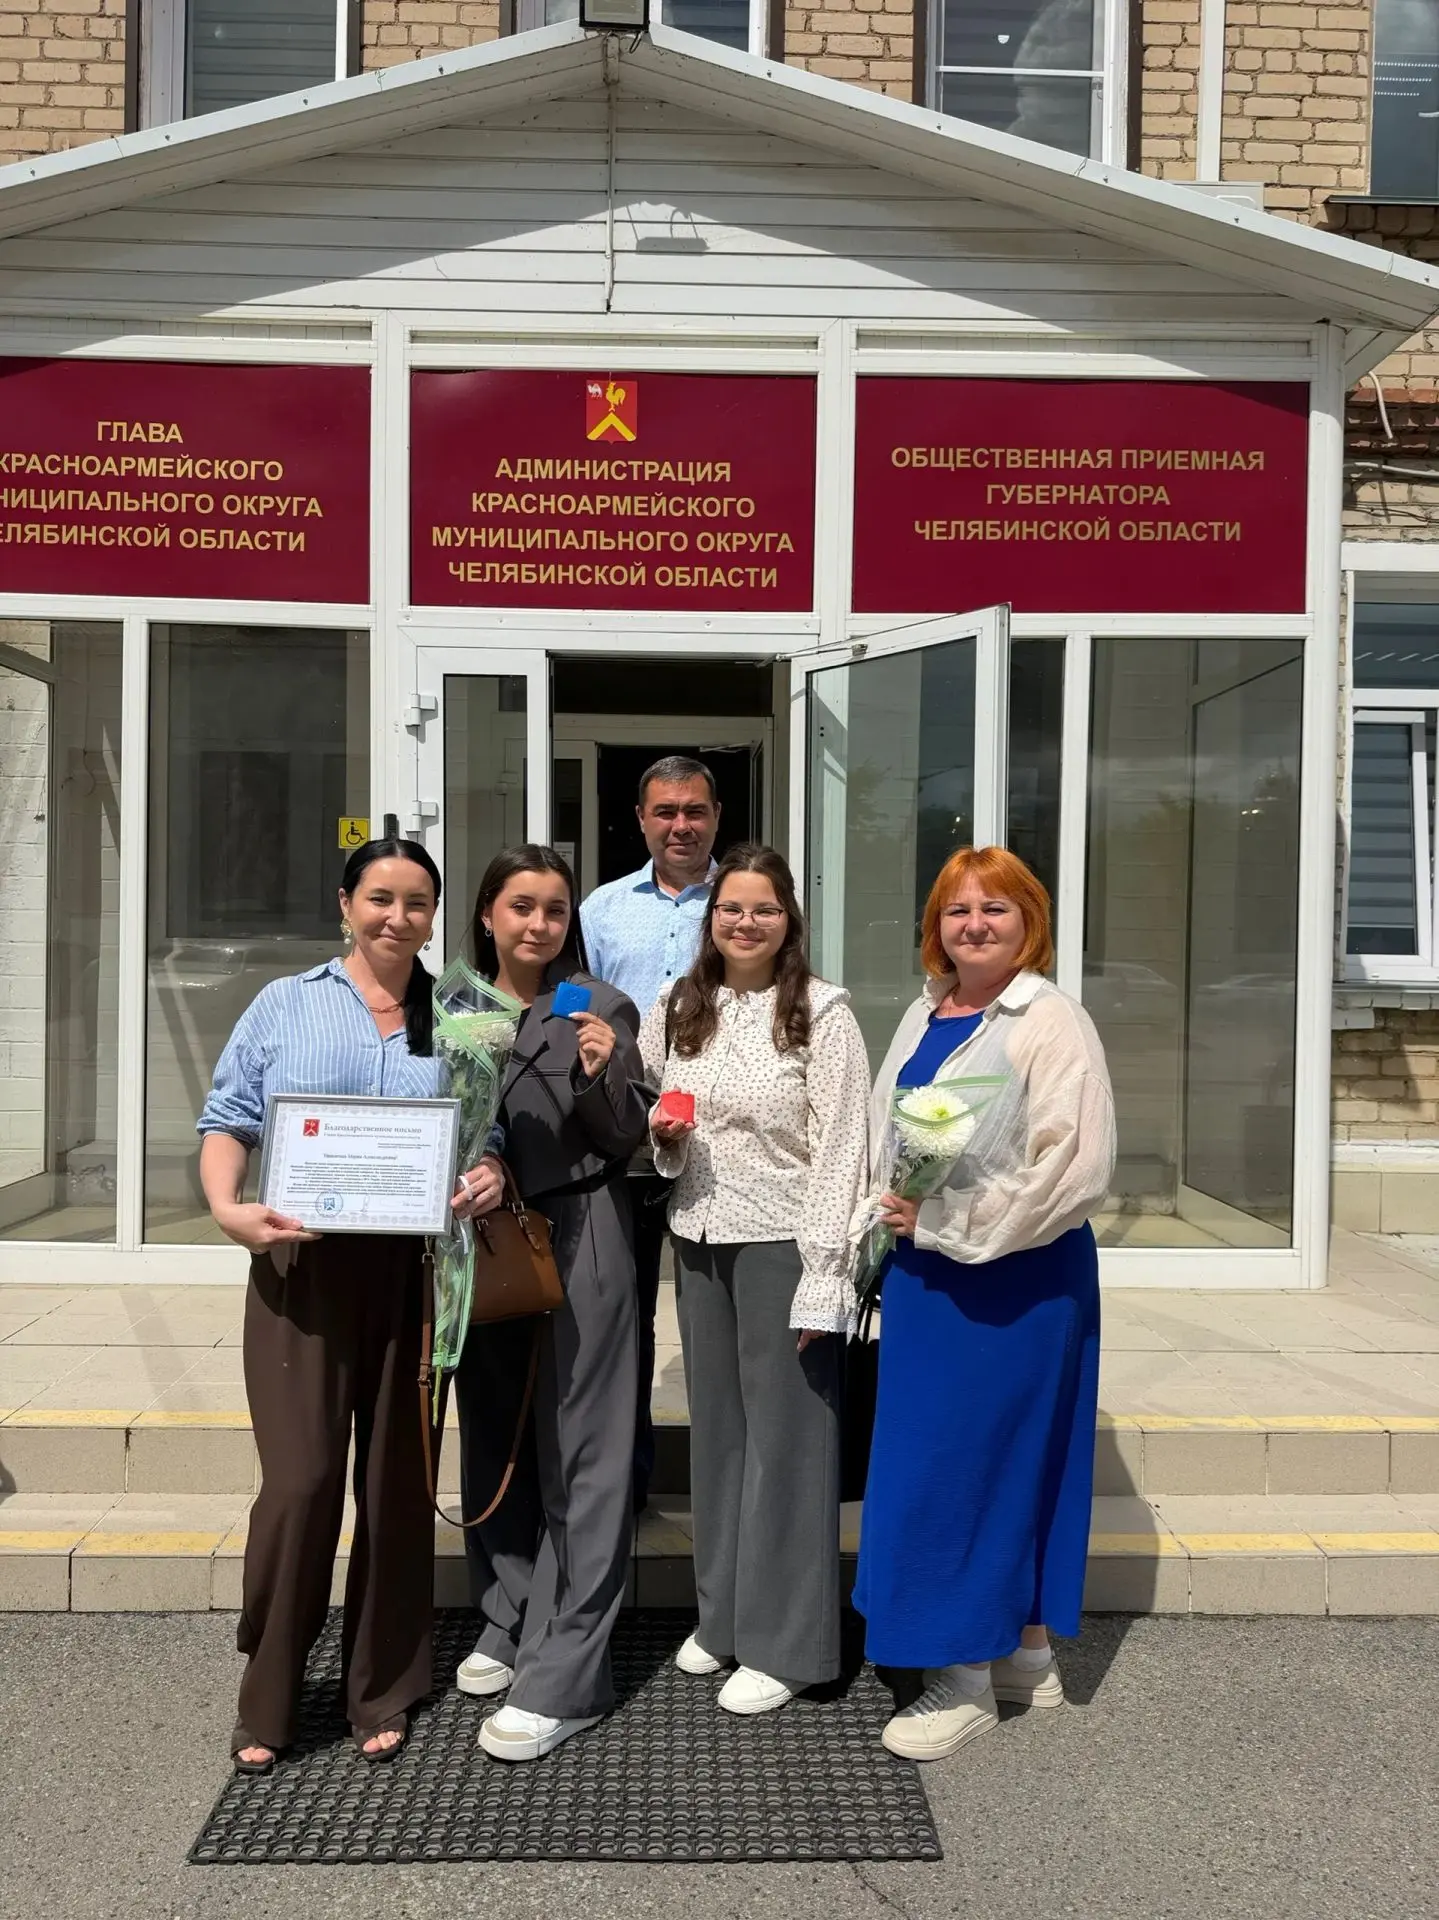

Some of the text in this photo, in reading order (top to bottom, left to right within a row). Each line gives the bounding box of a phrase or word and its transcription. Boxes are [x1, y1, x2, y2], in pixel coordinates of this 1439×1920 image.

[97, 421, 183, 444] ГЛАВА
[0, 453, 283, 481] КРАСНОАРМЕЙСКОГО
[495, 458, 731, 485] АДМИНИСТРАЦИЯ
[891, 447, 1264, 471] ОБЩЕСТВЕННАЯ ПРИЕМНАЯ
[222, 495, 323, 518] ОКРУГА
[472, 492, 755, 518] КРАСНОАРМЕЙСКОГО
[986, 484, 1170, 505] ГУБЕРНАТОРА
[0, 522, 305, 552] ЛЯБИНСКОЙ ОБЛАСТИ
[432, 526, 794, 553] МУНИЦИПАЛЬНОГО ОКРУГА
[914, 516, 1241, 542] ЧЕЛЯБИНСКОЙ ОБЛАСТИ
[448, 561, 777, 588] ЧЕЛЯБИНСКОЙ ОБЛАСТИ
